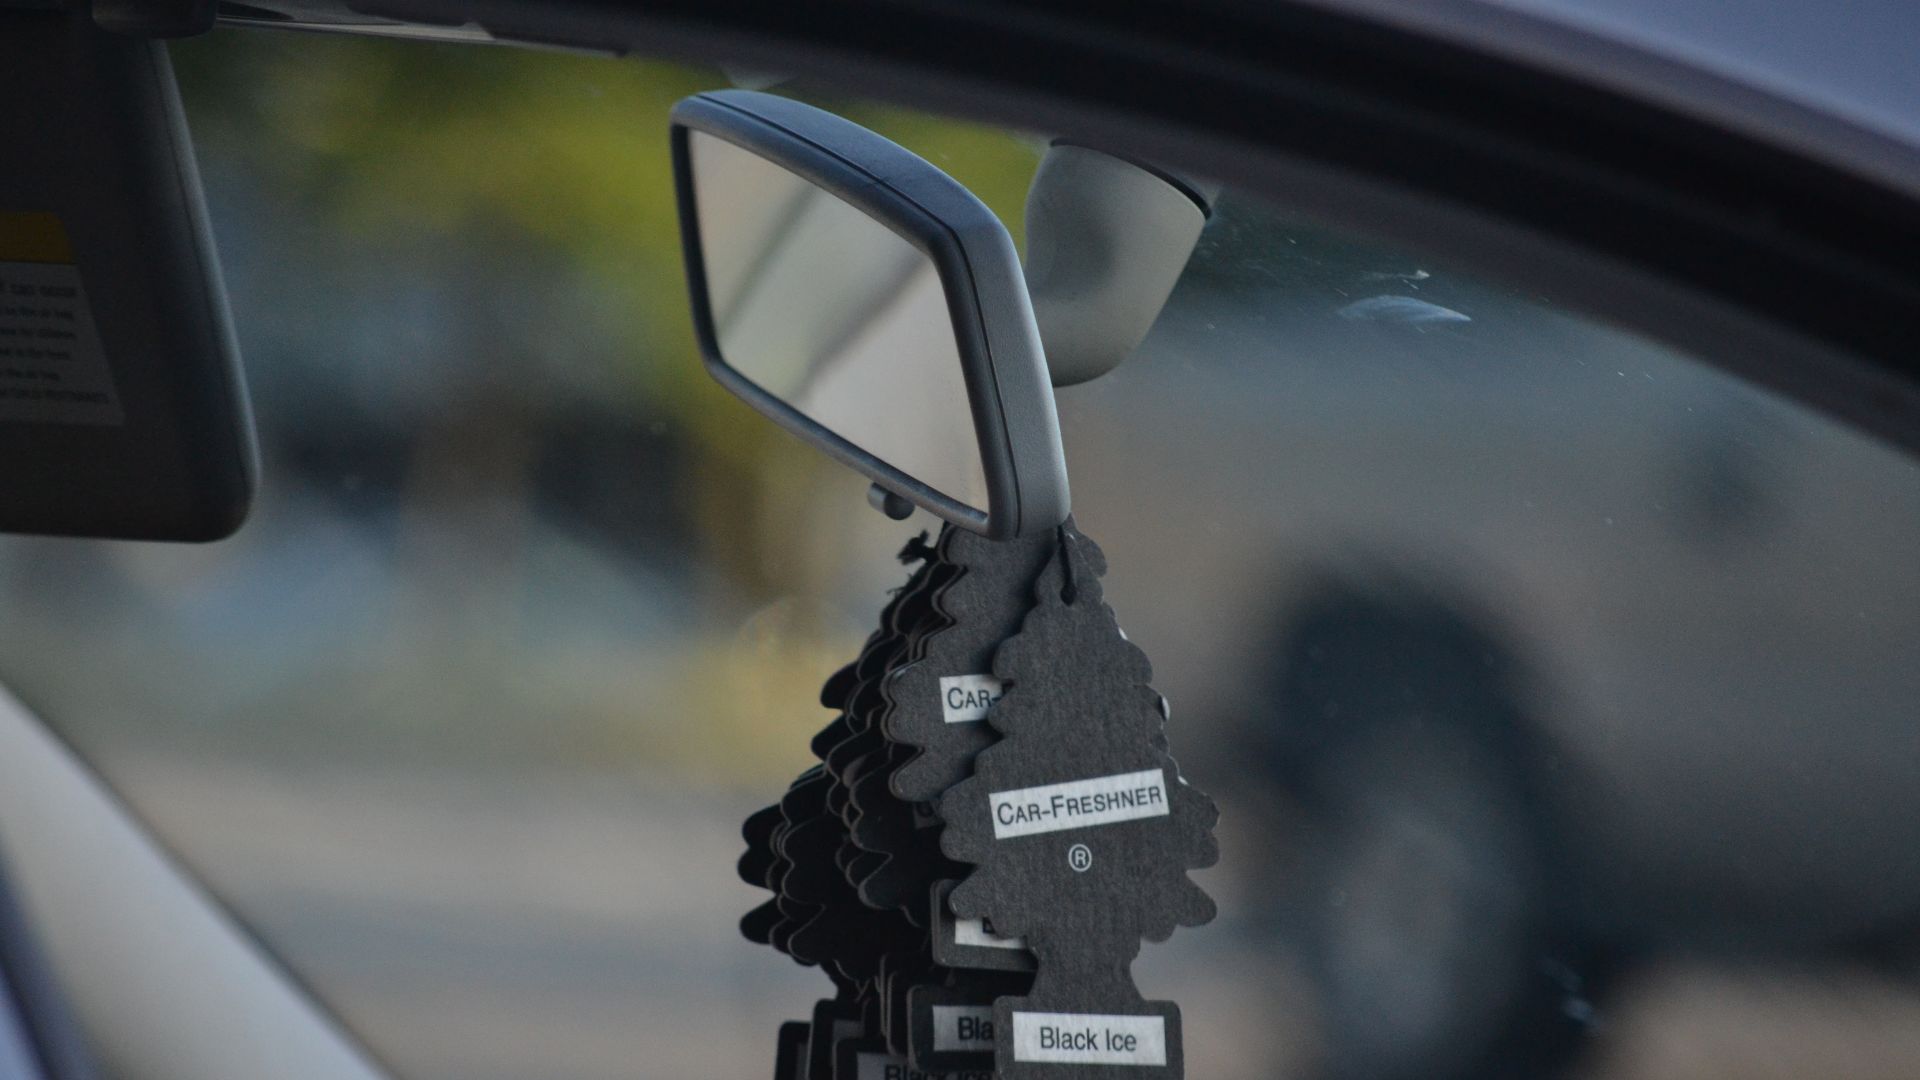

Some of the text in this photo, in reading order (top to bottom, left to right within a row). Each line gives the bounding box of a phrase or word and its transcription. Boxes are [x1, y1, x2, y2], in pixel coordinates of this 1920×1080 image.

[996, 785, 1164, 826] CAR-FRESHNER
[1040, 1026, 1137, 1052] Black Ice
